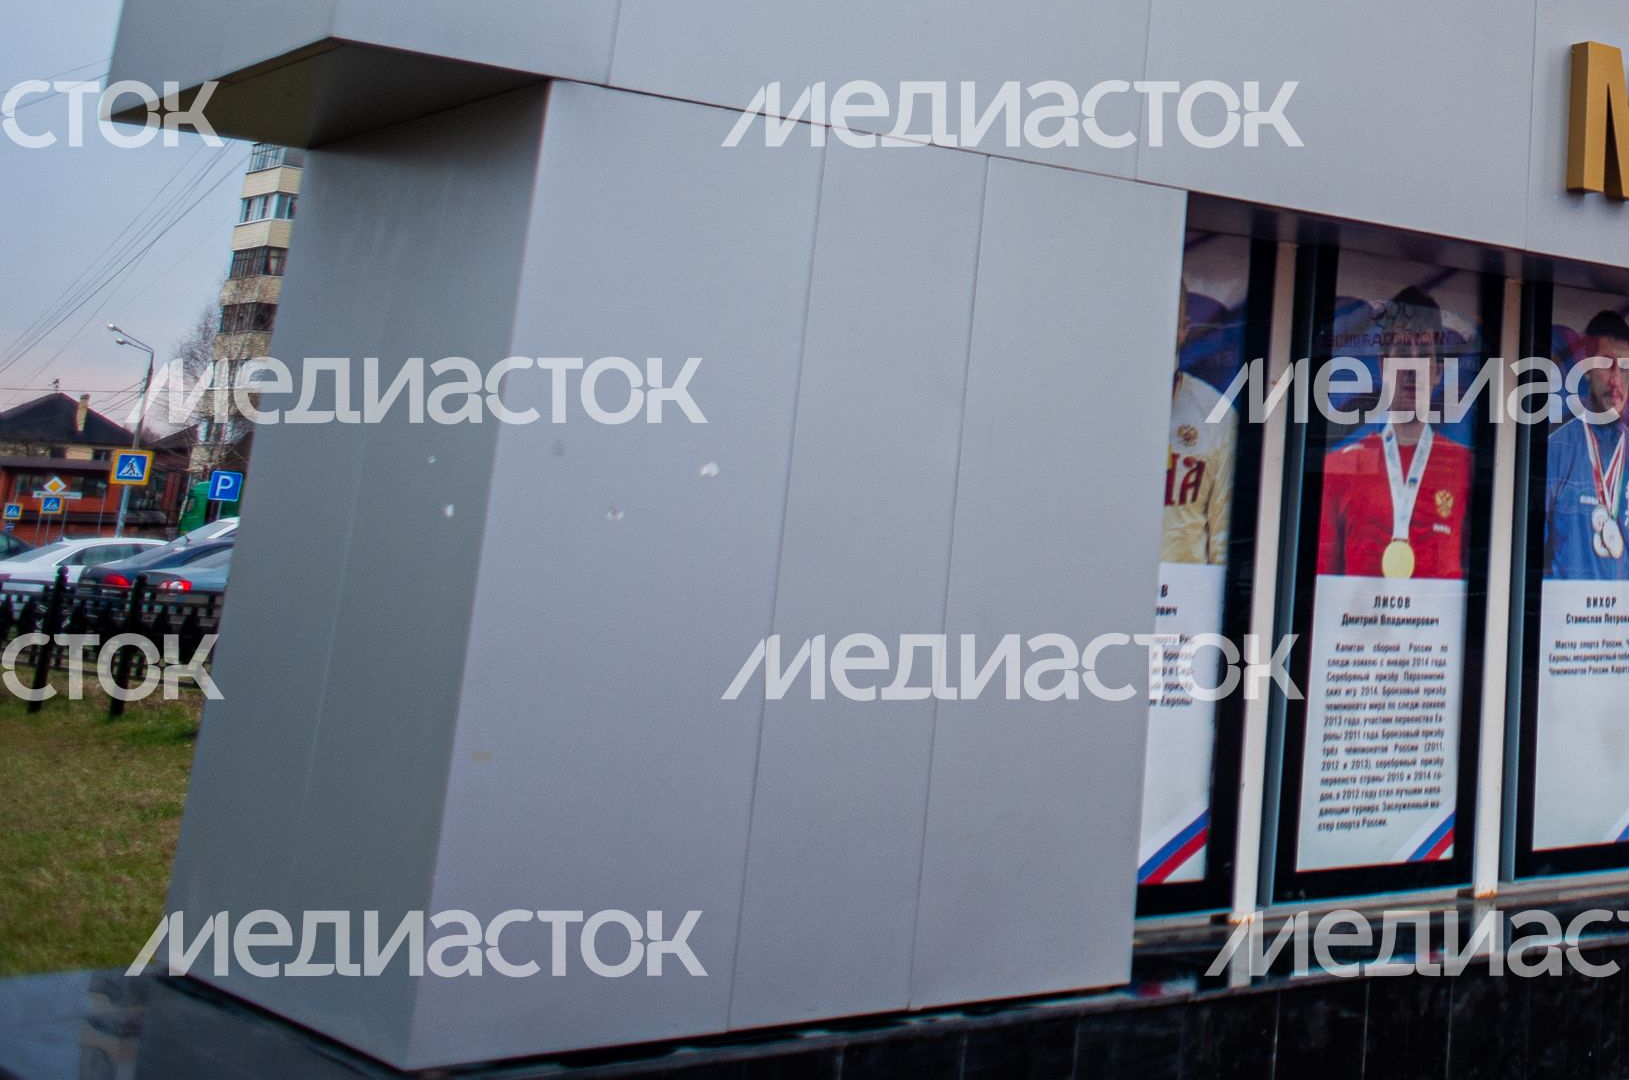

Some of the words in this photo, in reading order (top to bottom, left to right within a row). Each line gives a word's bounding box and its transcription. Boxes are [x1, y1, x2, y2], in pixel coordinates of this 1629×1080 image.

[216, 475, 233, 497] P
[1373, 595, 1411, 609] ЛИСОВ
[1586, 596, 1617, 608] ВИХОР
[1341, 612, 1378, 627] Дмитрий
[1380, 614, 1440, 627] Владимирович
[1566, 613, 1602, 624] Станислав
